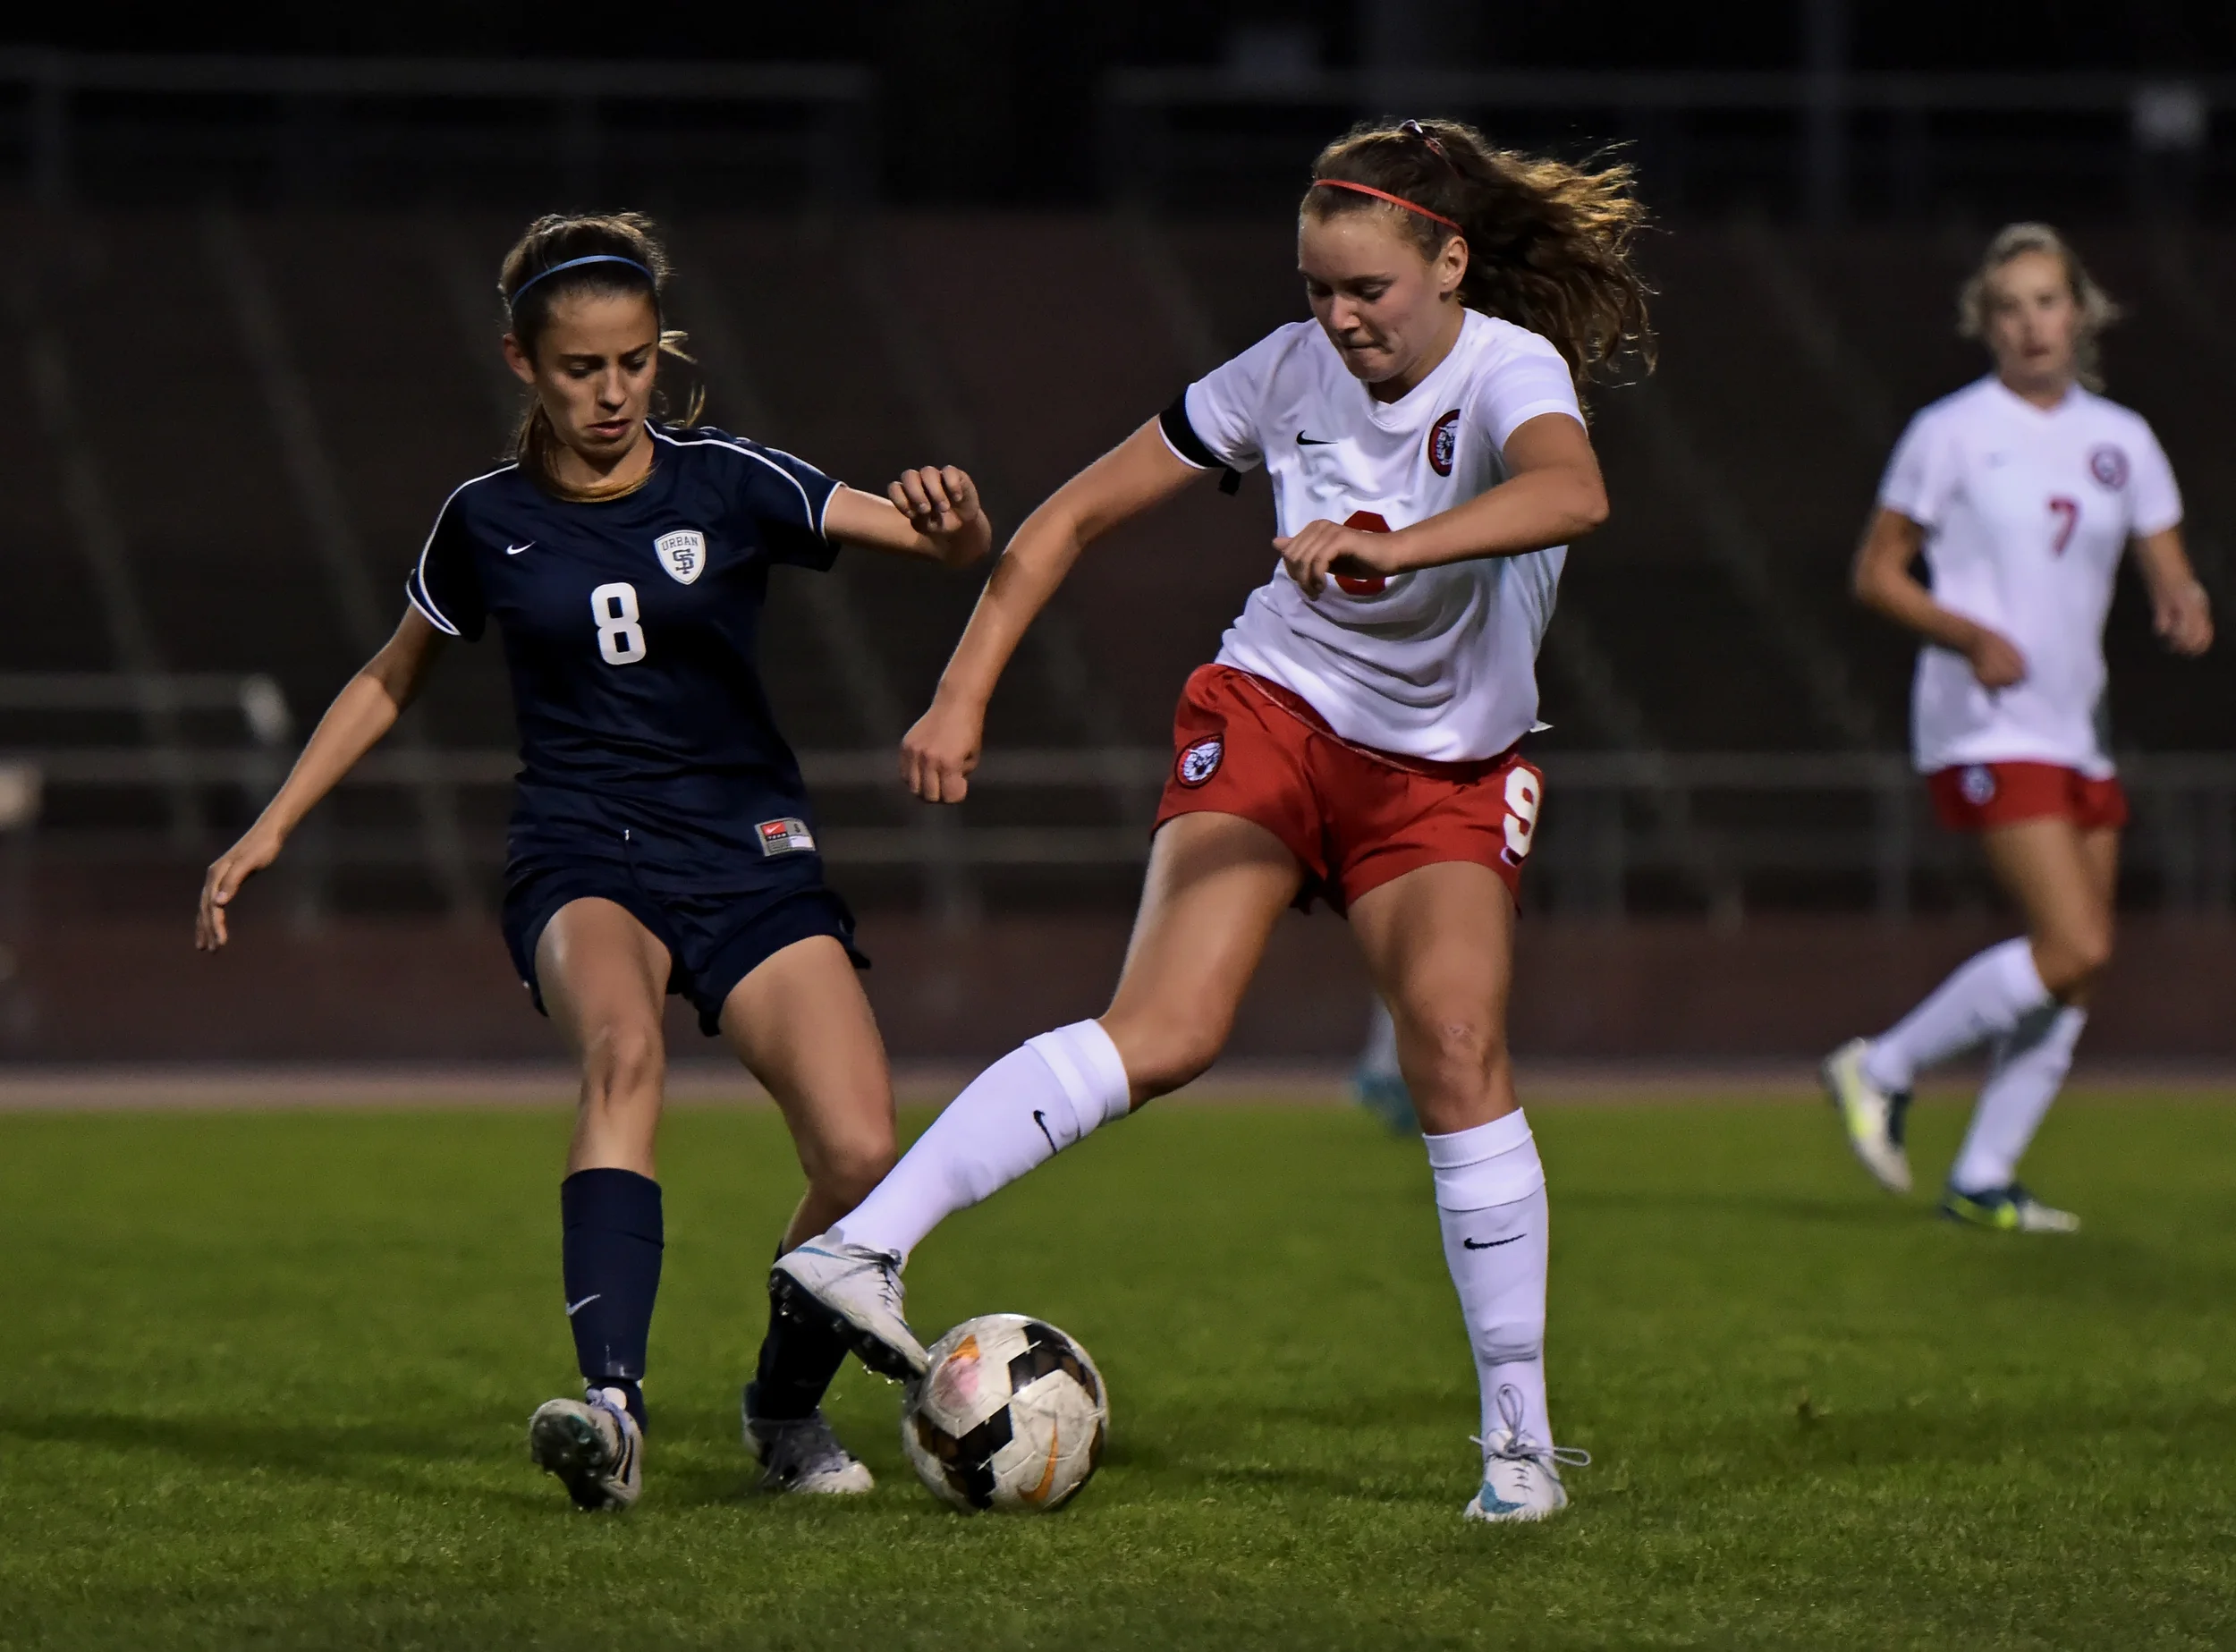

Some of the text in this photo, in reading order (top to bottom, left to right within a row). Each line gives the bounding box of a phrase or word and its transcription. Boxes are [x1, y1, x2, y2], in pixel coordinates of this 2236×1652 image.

[662, 537, 698, 551] URBAN
[2049, 496, 2079, 557] 7
[591, 582, 647, 665] 8
[1503, 766, 1540, 860] 9
